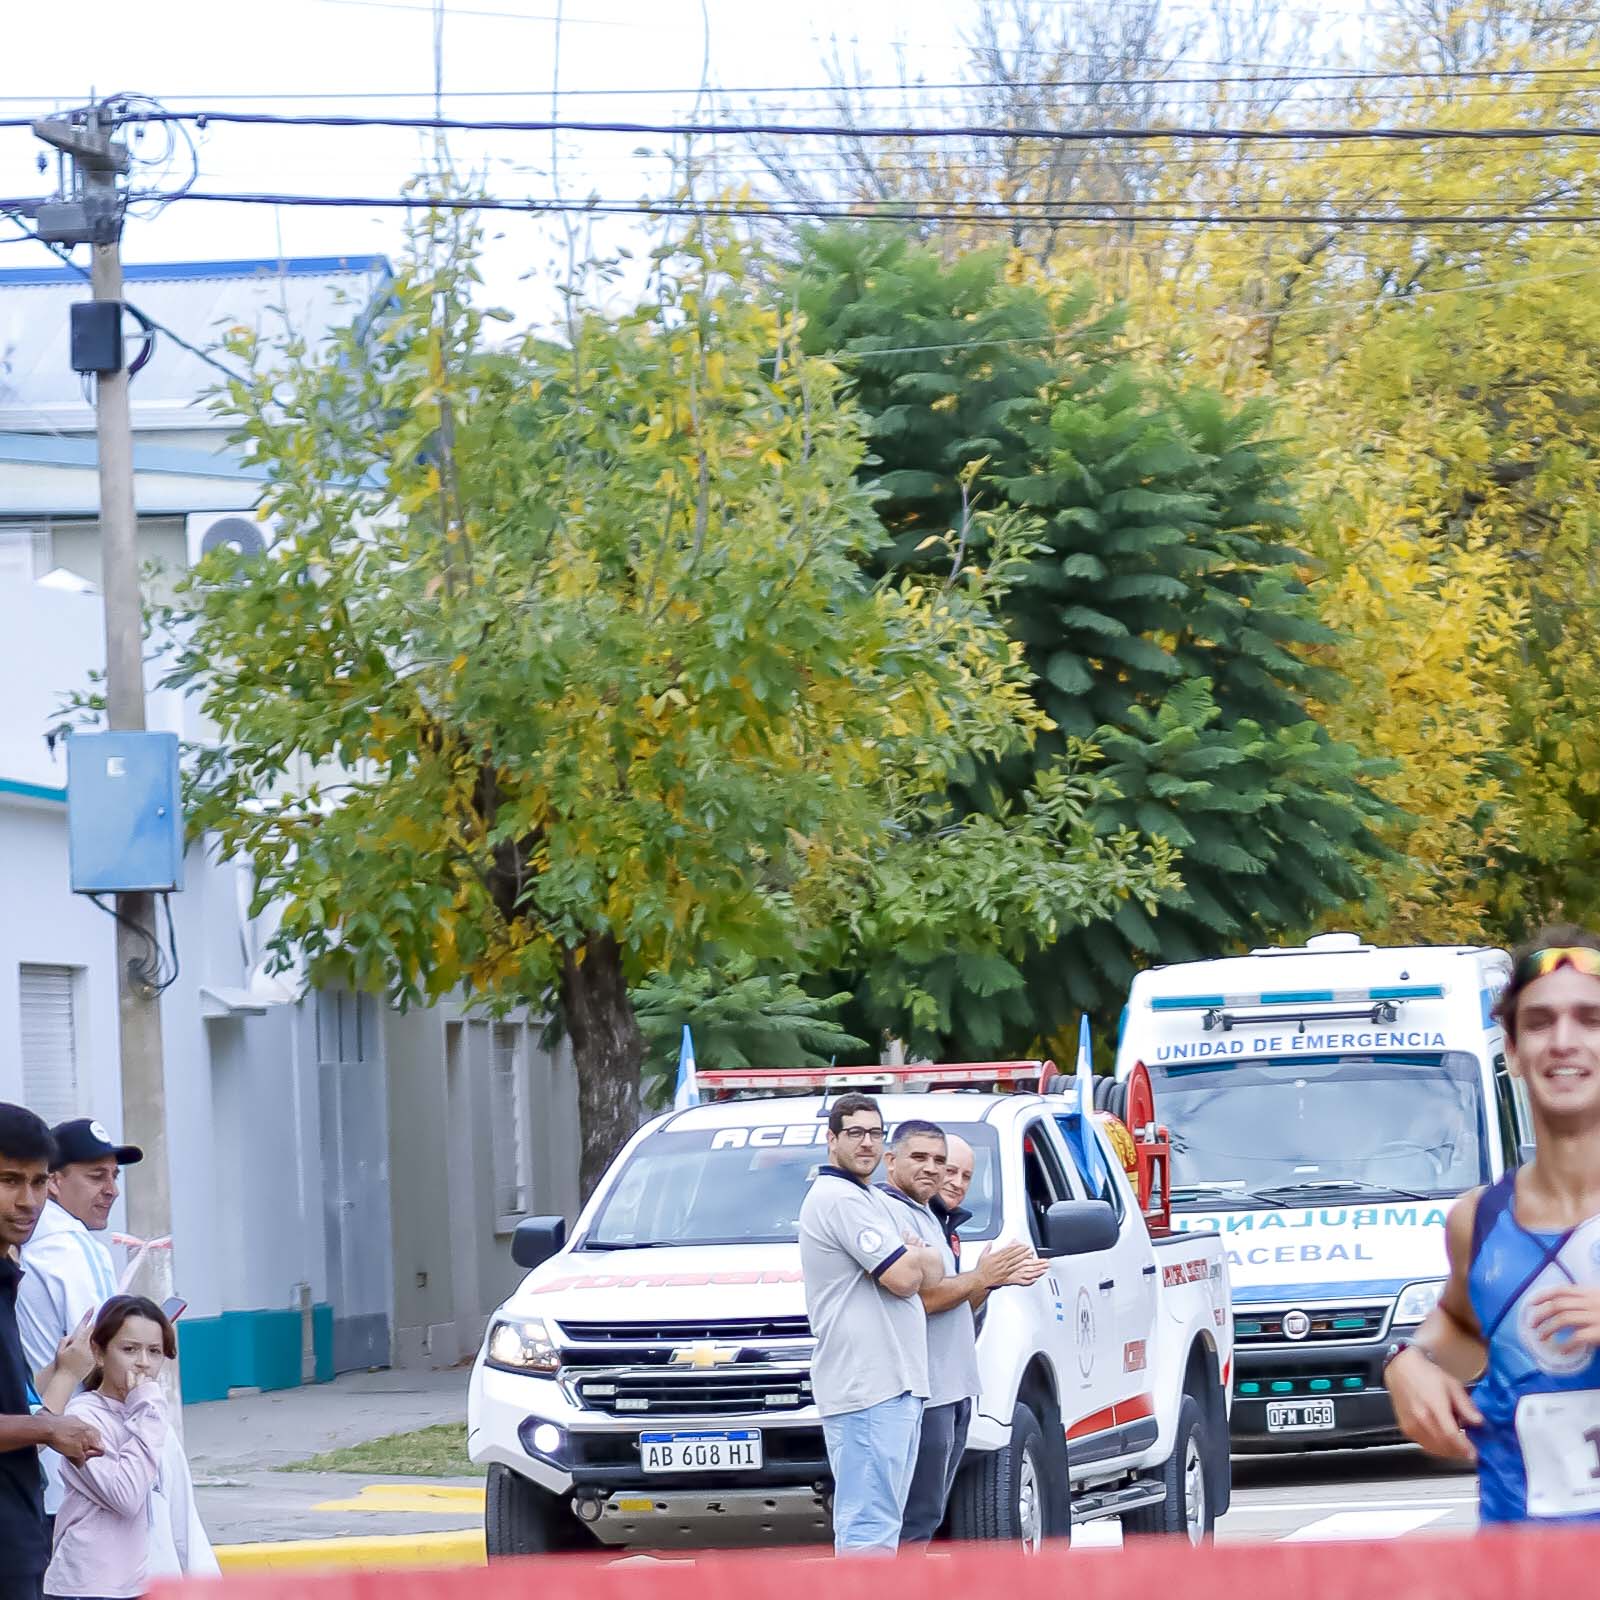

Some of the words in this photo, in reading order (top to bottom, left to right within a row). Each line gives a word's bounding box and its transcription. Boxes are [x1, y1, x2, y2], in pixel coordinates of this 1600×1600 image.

[1157, 1040, 1244, 1060] UNIDAD
[1253, 1037, 1282, 1052] DE
[1291, 1032, 1446, 1050] EMERGENCIA
[1222, 1243, 1373, 1265] ACEBAL
[1303, 1407, 1331, 1424] 058
[649, 1446, 673, 1467] AB
[682, 1445, 721, 1466] 608
[729, 1443, 754, 1465] HI
